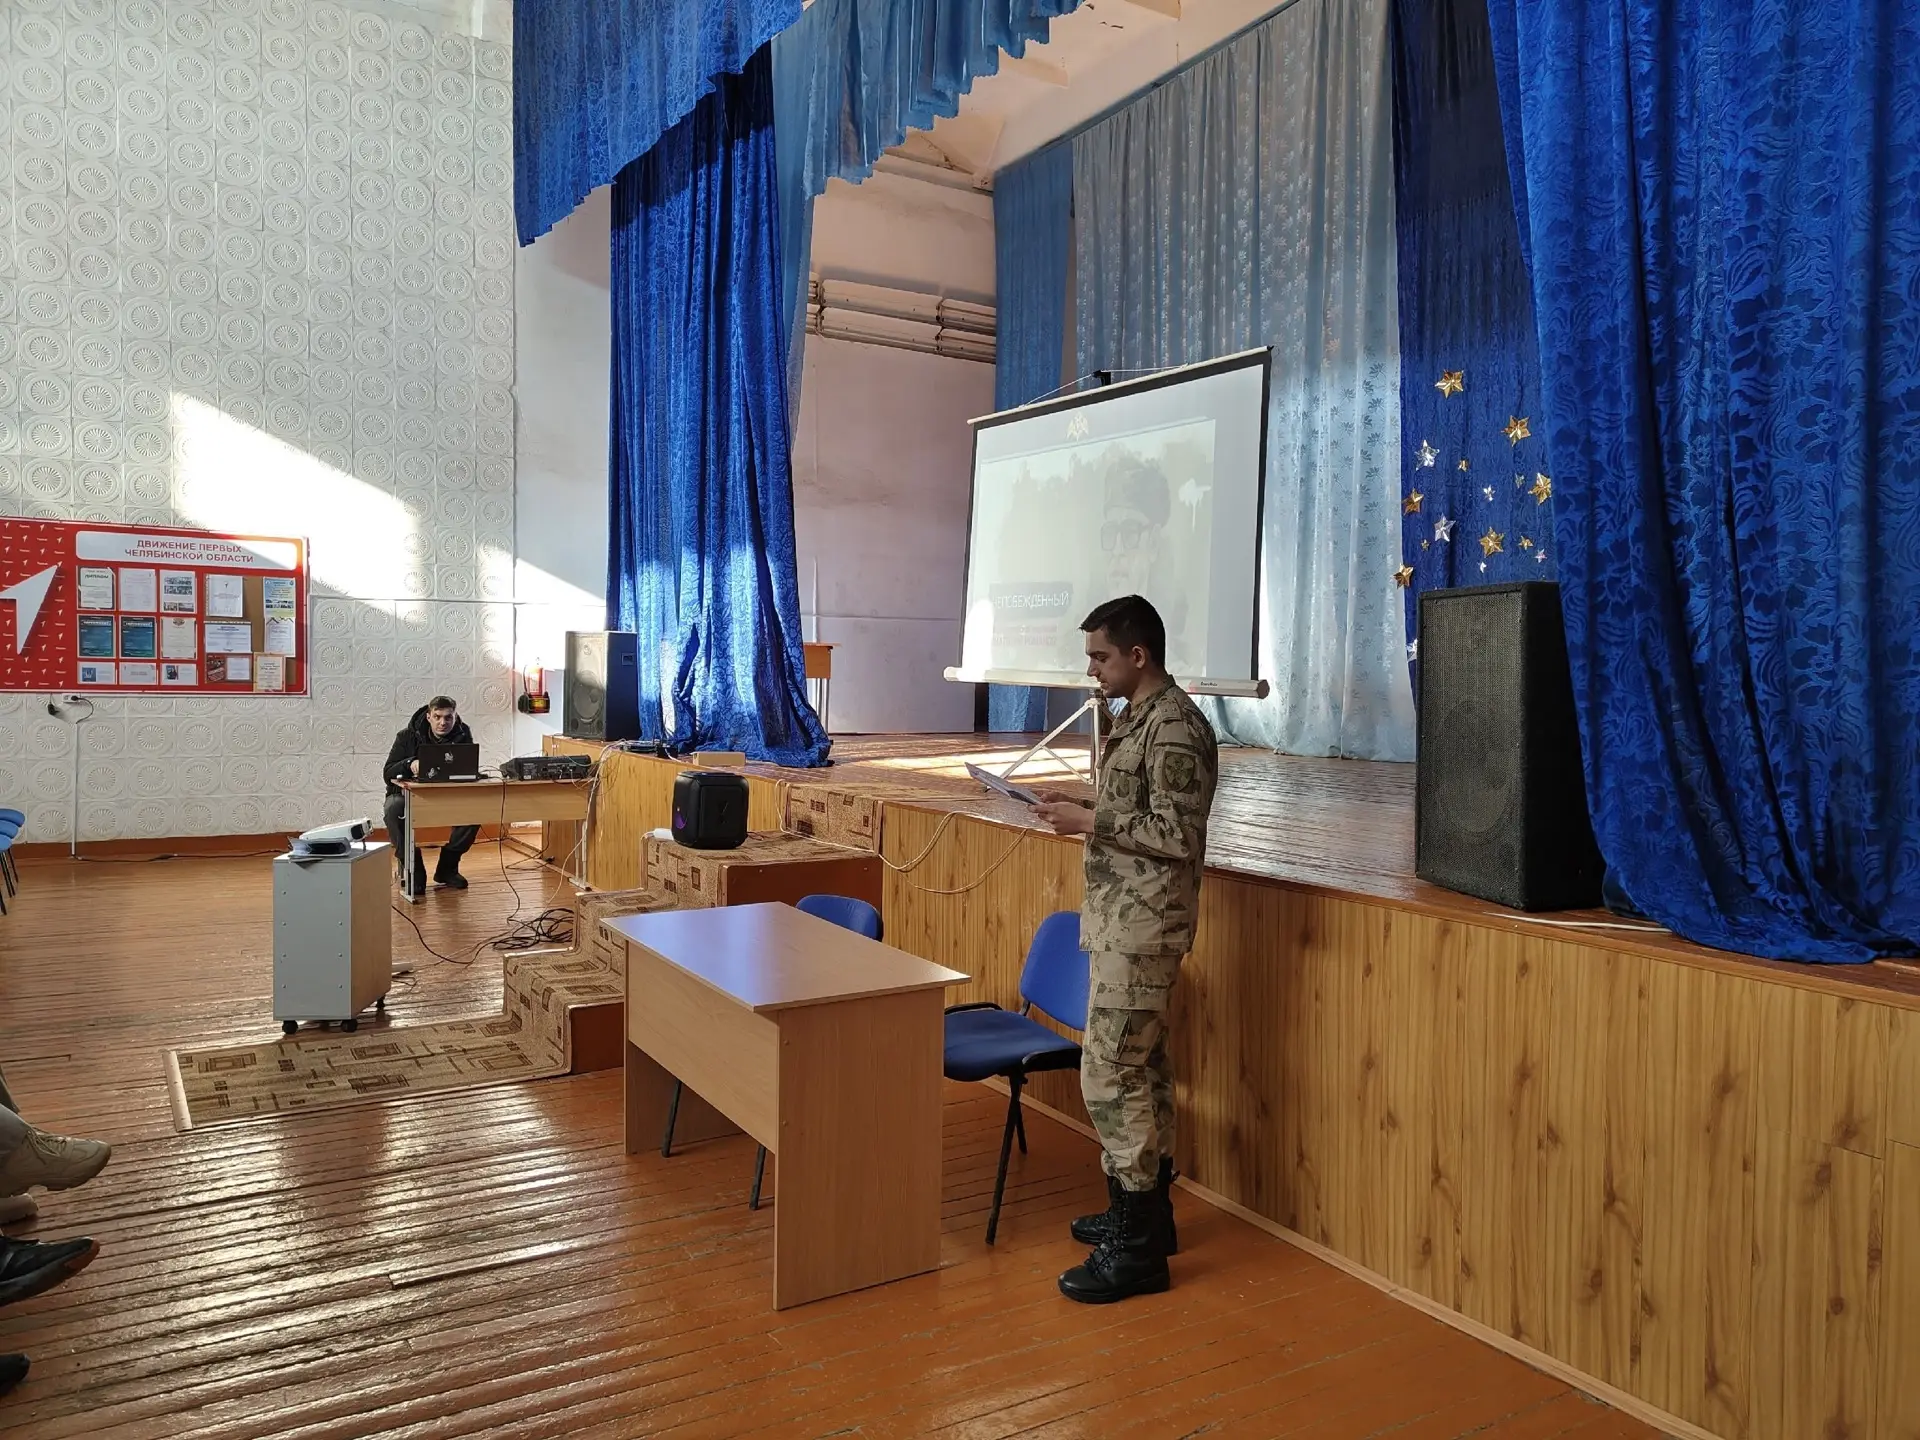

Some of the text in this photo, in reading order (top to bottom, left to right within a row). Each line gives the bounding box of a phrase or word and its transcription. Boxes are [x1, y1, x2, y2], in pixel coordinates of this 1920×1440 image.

[137, 540, 241, 552] ДВИЖЕНИЕ ПЕРВЫХ
[125, 549, 253, 562] ЧЕЛЯБИНСКОЙ ОБЛАСТИ
